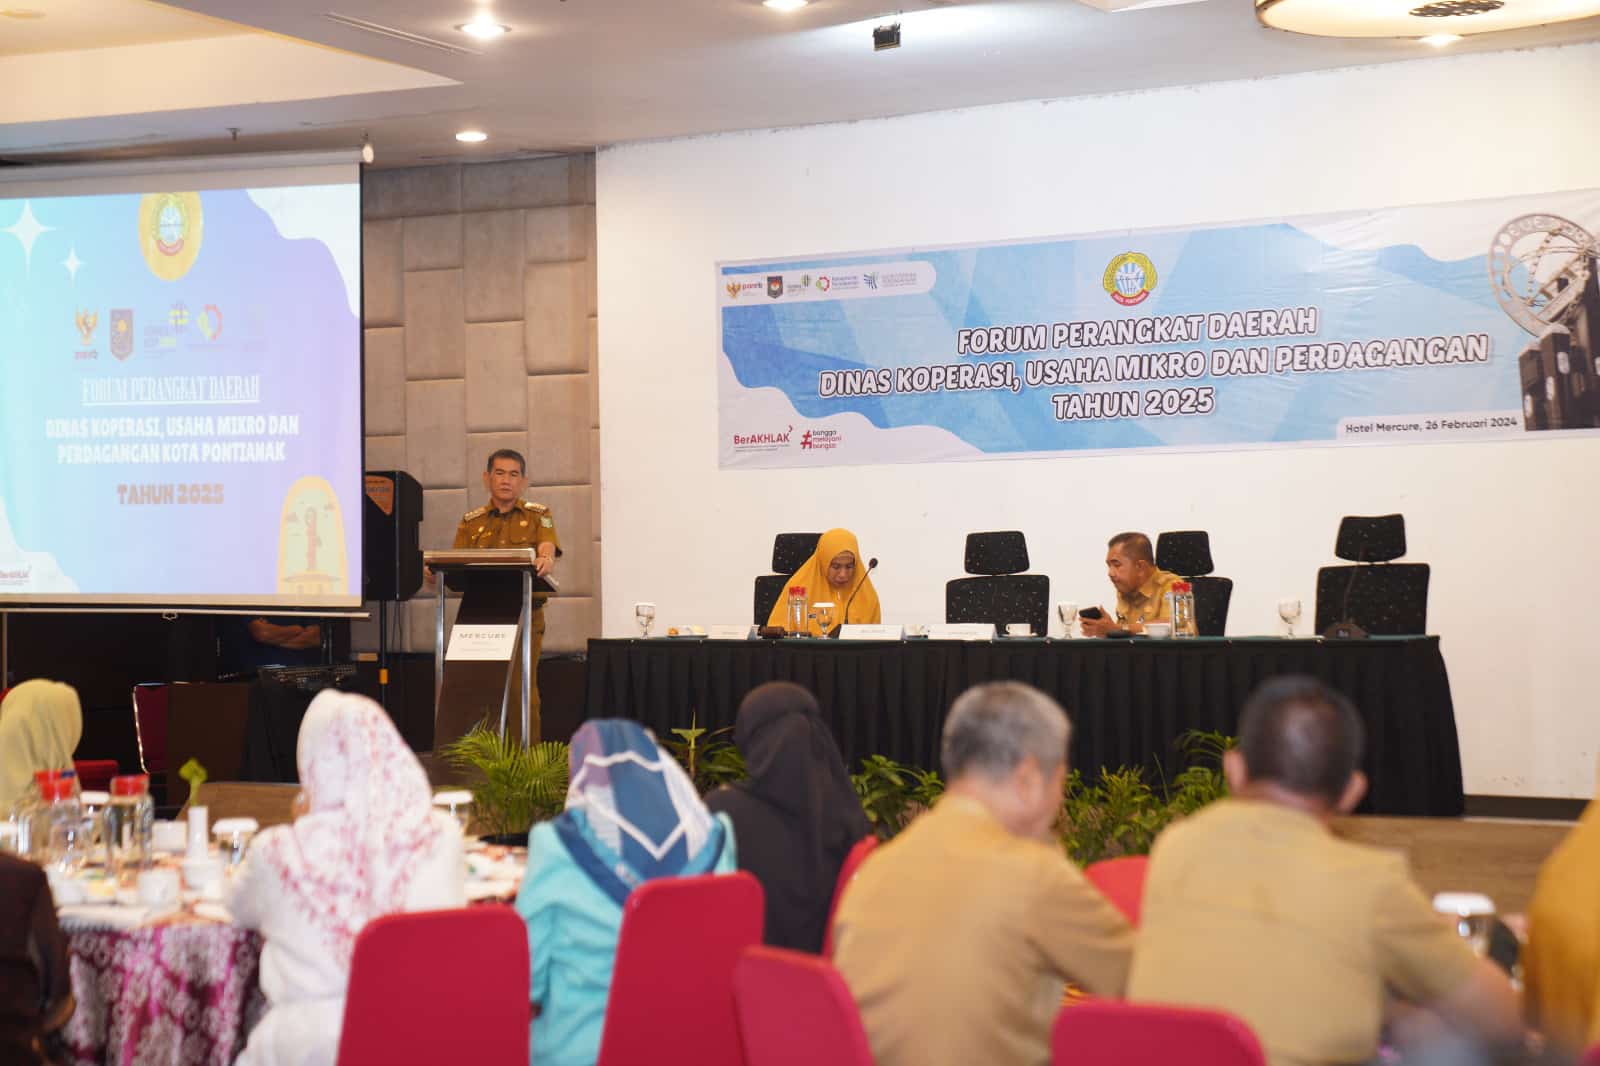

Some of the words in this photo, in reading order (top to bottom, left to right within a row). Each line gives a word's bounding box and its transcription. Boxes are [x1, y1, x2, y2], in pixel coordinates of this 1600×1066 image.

[958, 325, 1047, 354] FORUM
[1052, 314, 1204, 348] PERANGKAT
[1208, 307, 1318, 341] DAERAH
[819, 368, 891, 396] DINAS
[895, 361, 1021, 392] KOPERASI,
[1025, 356, 1113, 385] USAHA
[1115, 350, 1206, 381] MIKRO
[1210, 347, 1269, 377] DAN
[1274, 333, 1489, 373] PERDAGANGAN
[1051, 393, 1139, 420] TAHUN
[1144, 386, 1215, 415] 2025
[167, 416, 214, 437] USAHA
[217, 415, 265, 436] MIKRO
[269, 414, 299, 435] DAN
[1345, 423, 1373, 433] Hotel
[1376, 422, 1423, 433] Mercure,
[1425, 420, 1439, 430] 26
[1441, 418, 1487, 429] Februari
[1490, 416, 1518, 427] 2024
[733, 433, 790, 444] BerAKHLAK
[163, 443, 198, 463] KOTA
[202, 441, 286, 462] PONTIANAK
[117, 484, 174, 505] TAHUN
